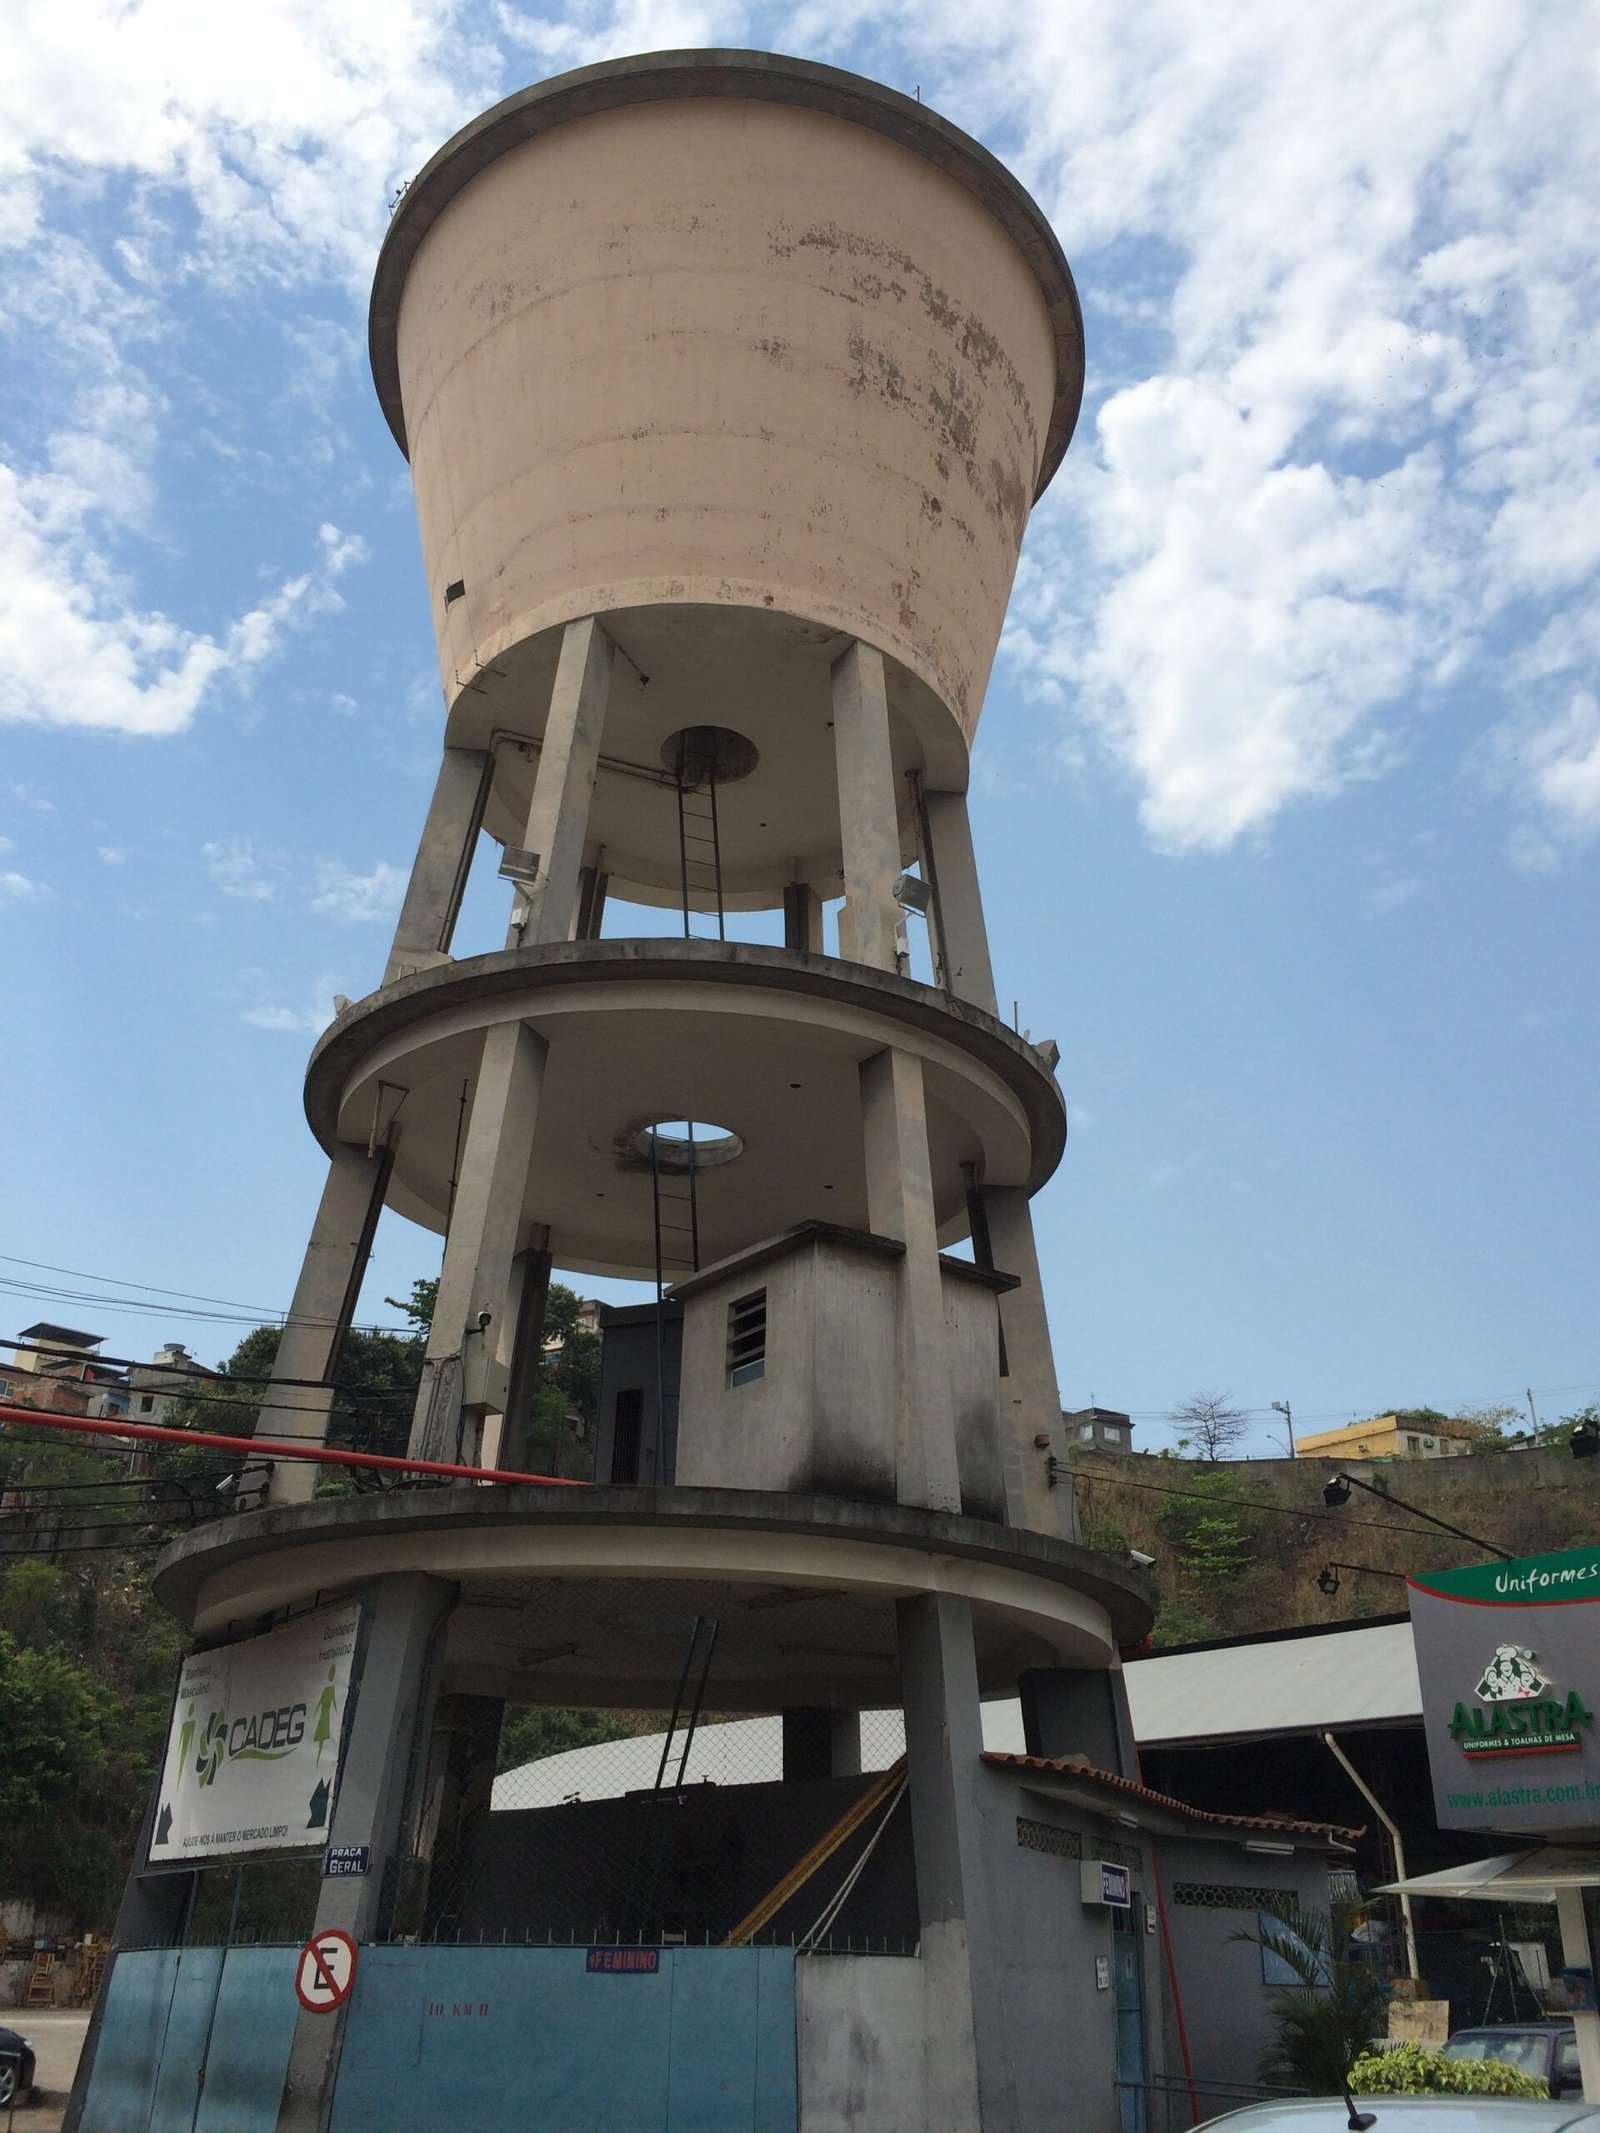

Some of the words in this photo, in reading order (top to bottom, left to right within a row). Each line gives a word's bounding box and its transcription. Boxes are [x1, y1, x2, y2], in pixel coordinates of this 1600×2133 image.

[1494, 1563, 1598, 1594] Uniformes
[1447, 1690, 1594, 1740] ALASTRA
[228, 1702, 307, 1757] CADEG
[1463, 1738, 1502, 1749] UNIFORMES
[1504, 1738, 1509, 1747] &
[1511, 1736, 1543, 1746] TOALHAS
[1544, 1734, 1553, 1743] DE
[1555, 1732, 1575, 1742] MESA
[242, 1827, 269, 1841] MERCADO
[330, 1859, 364, 1874] GERAL
[595, 1950, 657, 1970] FEMININO
